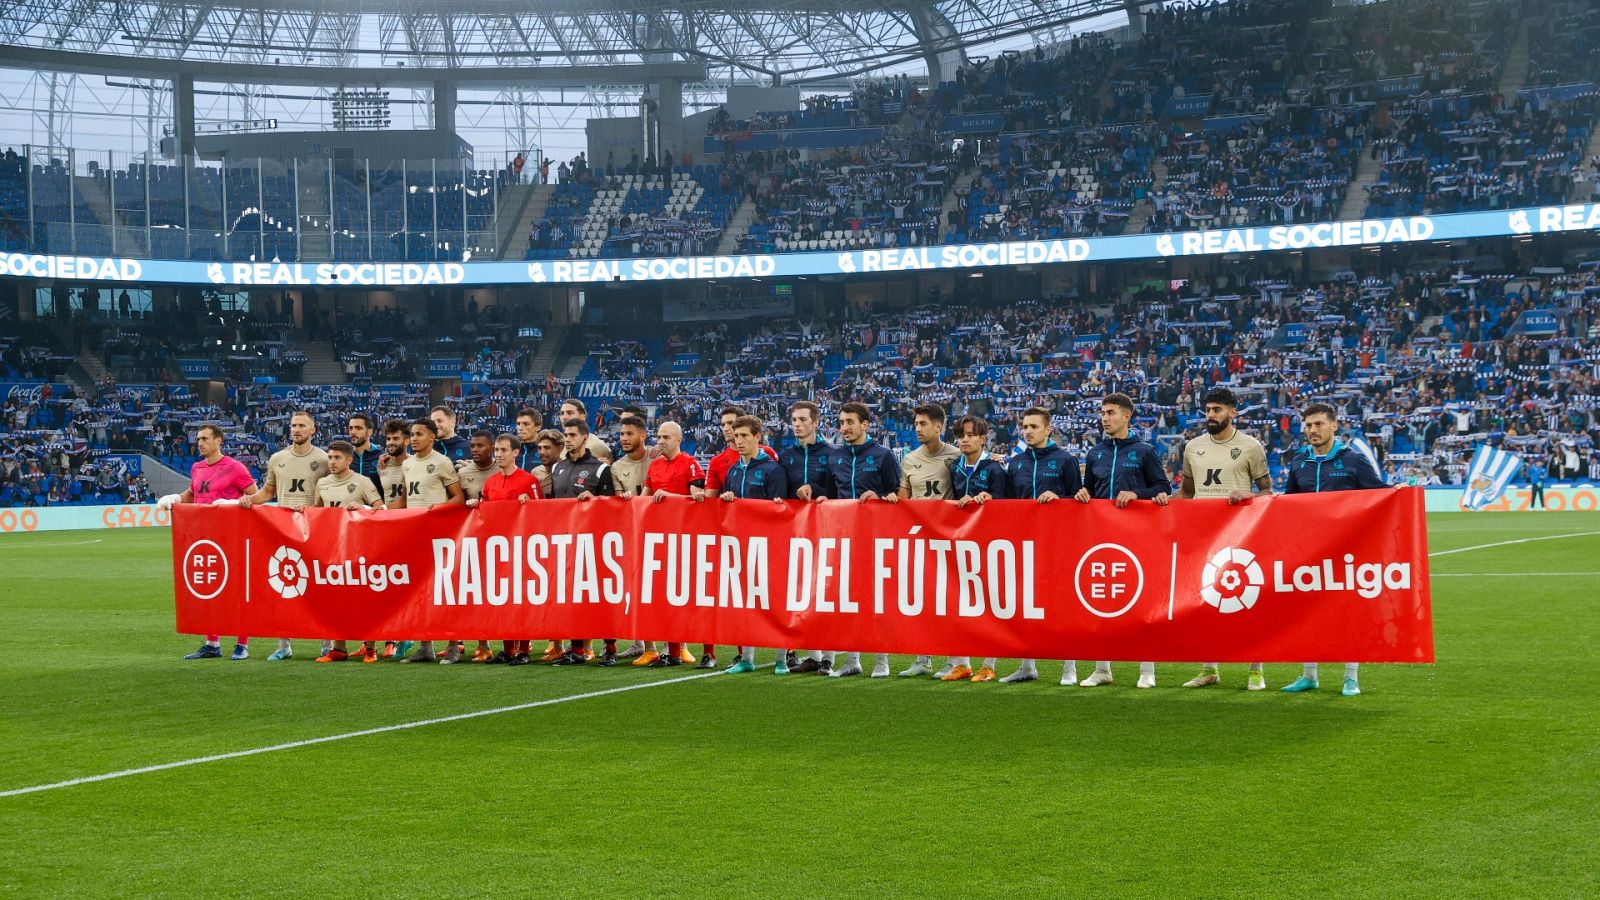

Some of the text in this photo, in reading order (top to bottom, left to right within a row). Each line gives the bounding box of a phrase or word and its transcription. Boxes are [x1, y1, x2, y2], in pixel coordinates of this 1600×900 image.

[1182, 216, 1434, 256] REAL SOCIEDAD
[553, 256, 775, 283] REAL SOCIEDAD
[863, 238, 1090, 272] REAL SOCIEDAD
[232, 262, 465, 285] REAL SOCIEDAD
[1526, 316, 1556, 325] KEL
[8, 384, 43, 401] Coca-Co
[102, 505, 172, 528] CAZO
[312, 556, 410, 592] LaLiga
[432, 525, 1045, 620] RACISTAS, FUERA DEL FÚTBOL
[1273, 553, 1411, 599] LaLiga
